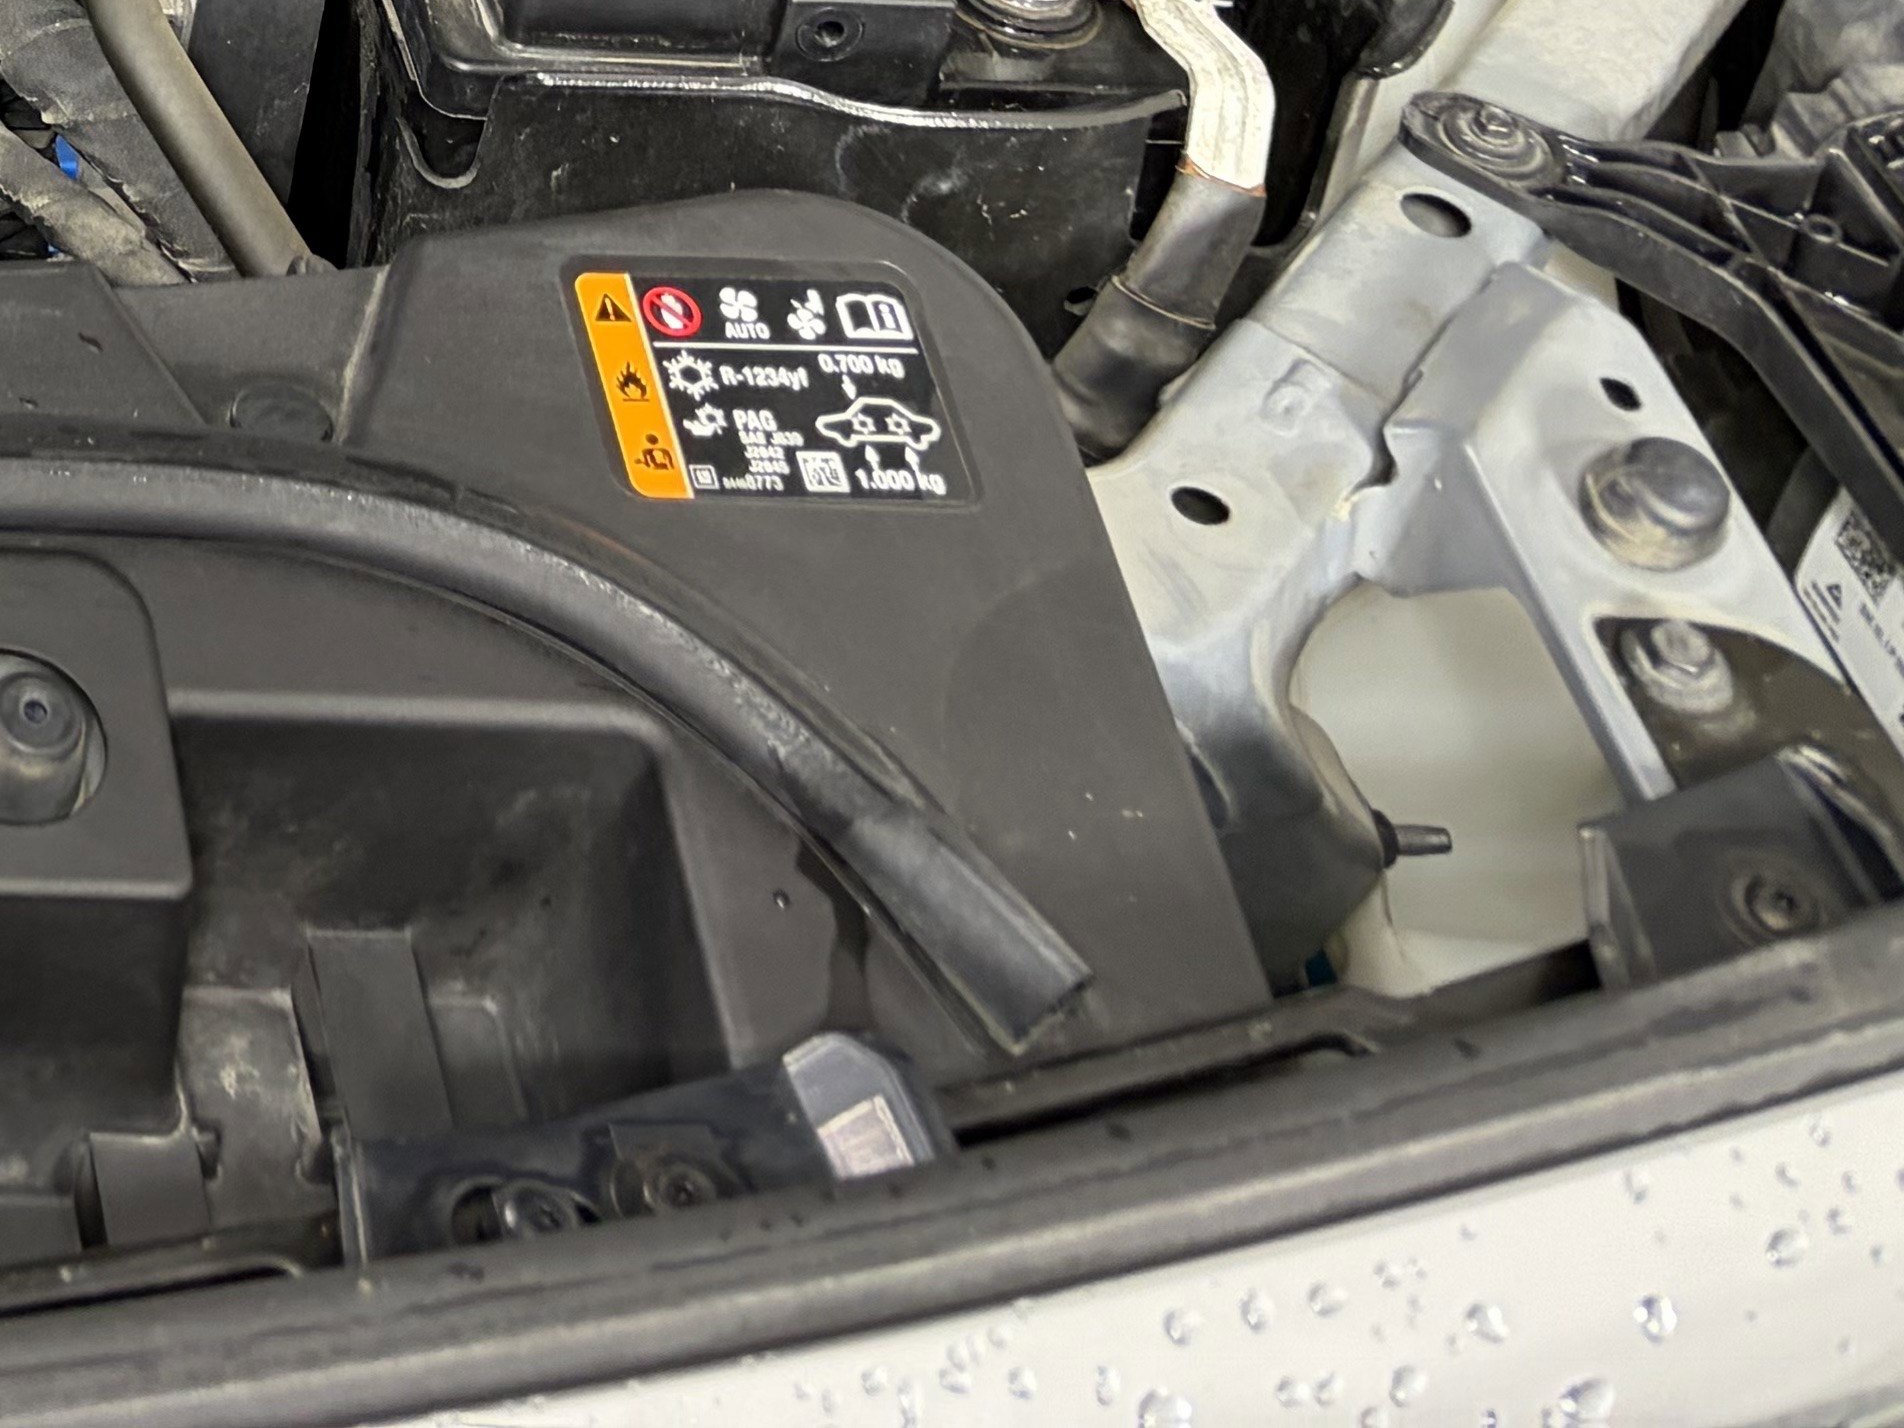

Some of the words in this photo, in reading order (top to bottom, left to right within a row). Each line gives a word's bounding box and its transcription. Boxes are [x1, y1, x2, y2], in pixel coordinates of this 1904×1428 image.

[725, 322, 771, 339] AUTO
[719, 365, 809, 391] R-1234yf
[817, 353, 874, 375] 0.700
[874, 354, 906, 379] kg
[732, 409, 778, 431] PAG
[854, 467, 916, 491] 1.000
[918, 472, 947, 496] kg
